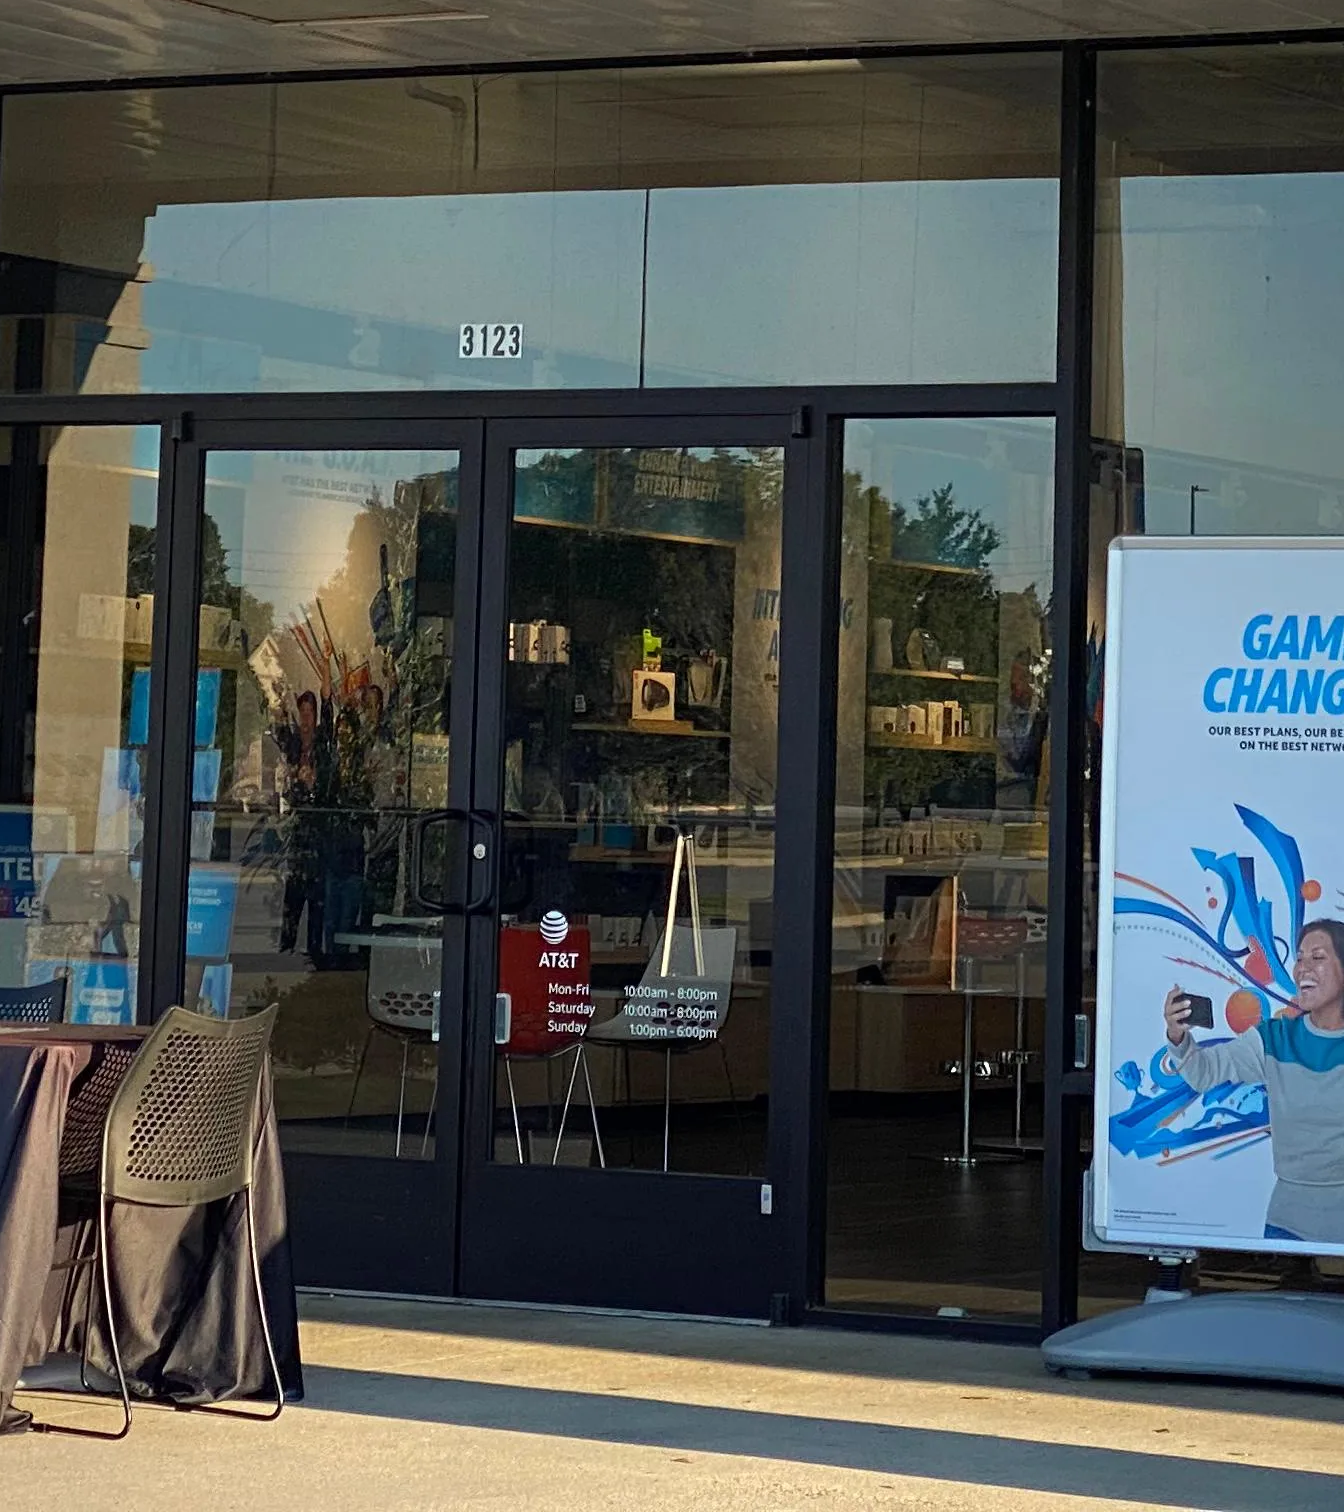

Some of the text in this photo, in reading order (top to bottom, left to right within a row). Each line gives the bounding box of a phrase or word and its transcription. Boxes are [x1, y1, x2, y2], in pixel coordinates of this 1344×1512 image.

[462, 325, 520, 356] 3123
[1208, 726, 1232, 736] OUR
[1234, 726, 1261, 737] BEST
[1263, 727, 1302, 739] PLANS,
[1304, 727, 1328, 737] OUR
[1239, 740, 1255, 750] ON
[1258, 741, 1279, 751] THE
[1281, 741, 1309, 751] BEST
[539, 952, 579, 969] AT&T
[548, 983, 589, 996] Mon-Fri
[624, 986, 667, 999] 10:00am
[677, 988, 717, 1001] 8:00pm
[548, 1001, 595, 1017] Saturday
[624, 1004, 668, 1017] 10:00am
[677, 1007, 717, 1021] 8:00pm
[547, 1020, 587, 1035] Sunday
[677, 1026, 717, 1039] 6:00pm
